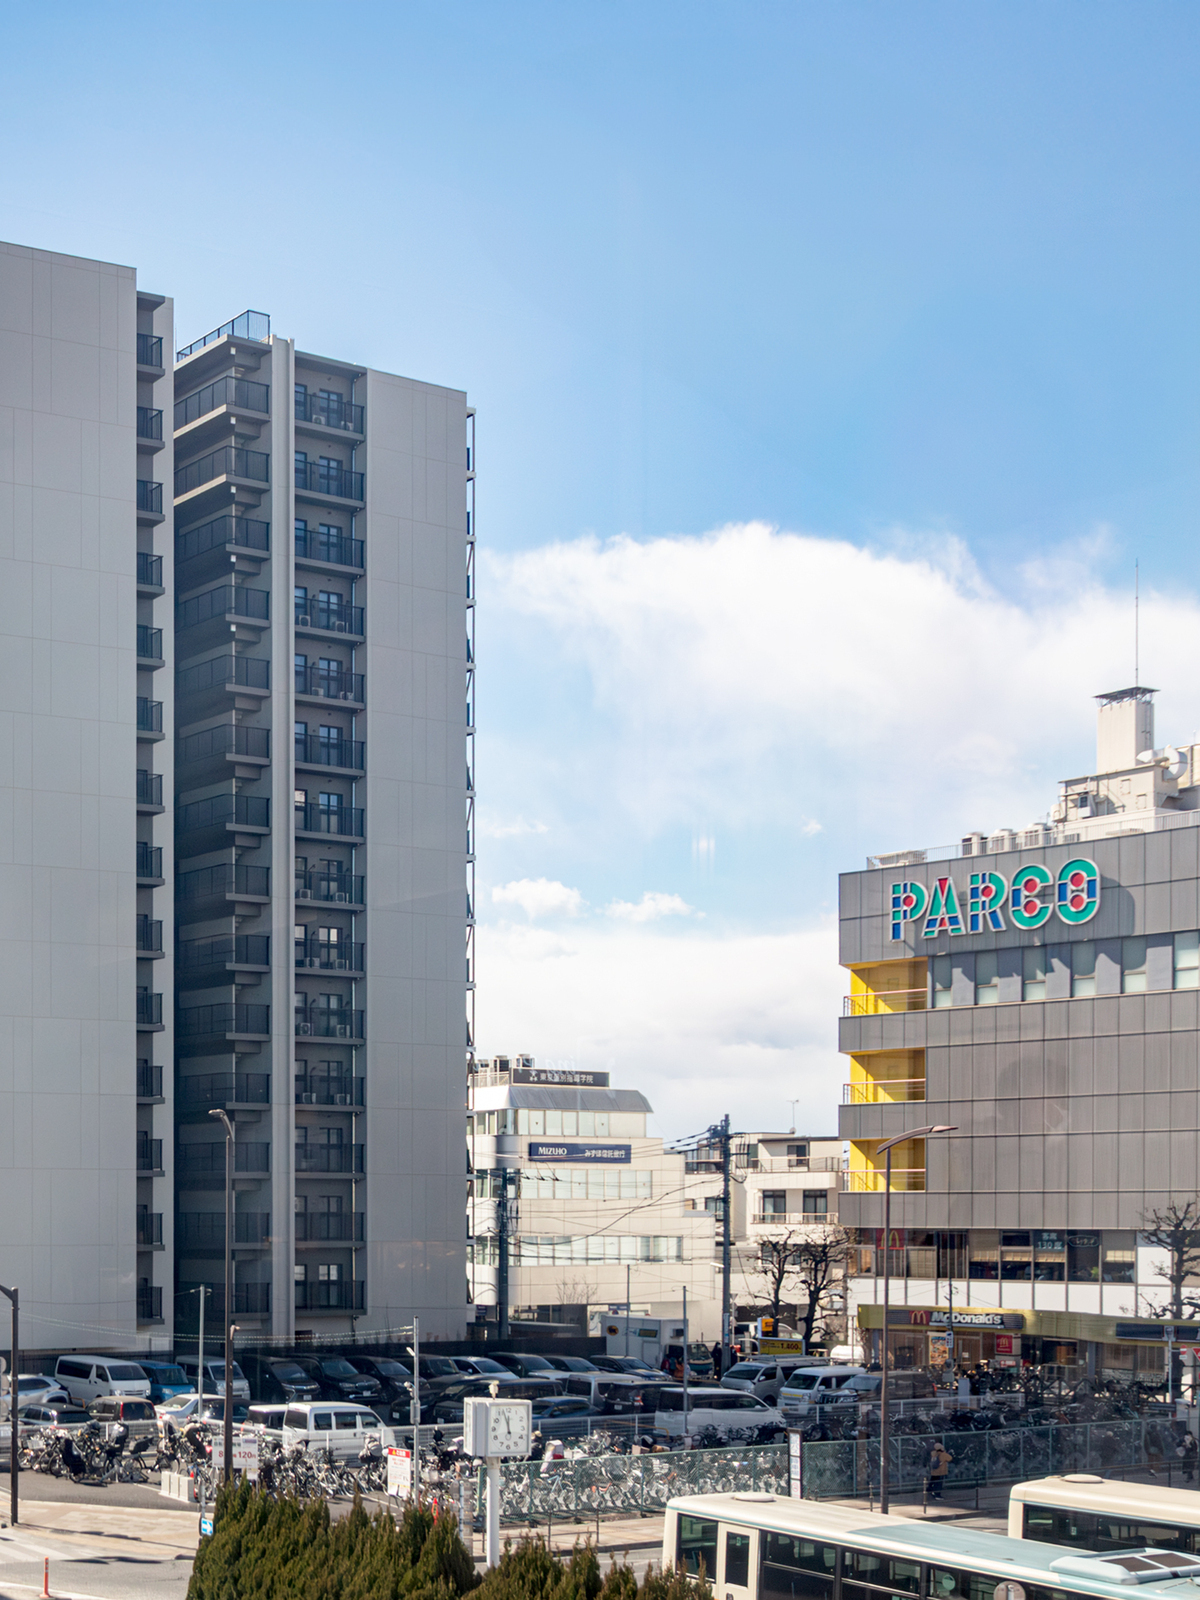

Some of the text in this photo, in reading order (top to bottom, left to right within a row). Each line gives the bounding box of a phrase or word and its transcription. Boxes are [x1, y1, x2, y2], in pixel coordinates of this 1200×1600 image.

[890, 857, 1100, 942] PARCO
[538, 1146, 567, 1155] MIZUHO
[931, 1311, 1002, 1325] McDonald's
